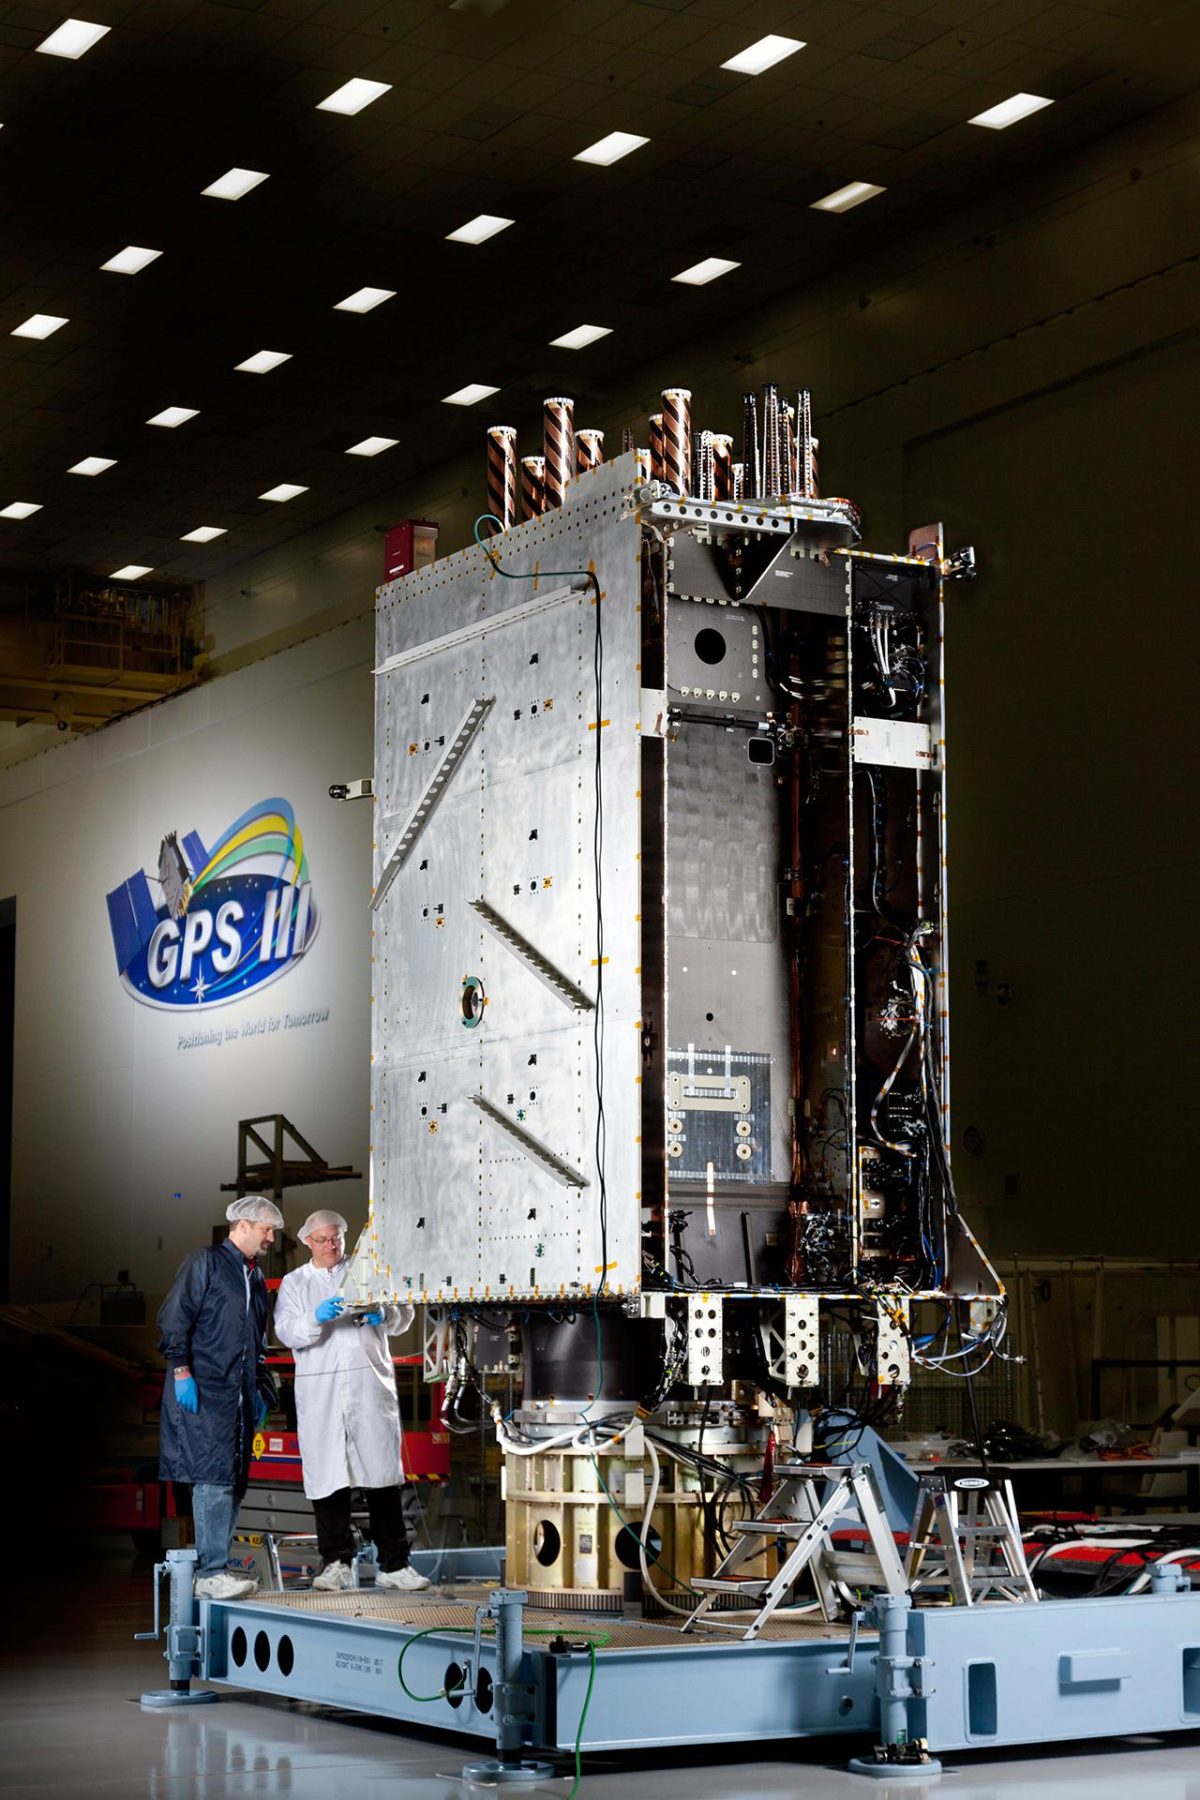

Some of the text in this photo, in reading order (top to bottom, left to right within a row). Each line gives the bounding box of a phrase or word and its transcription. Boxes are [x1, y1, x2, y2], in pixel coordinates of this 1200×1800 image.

[147, 881, 312, 988] GPS III
[177, 1008, 330, 1051] Positioning the World for Tomorrow
